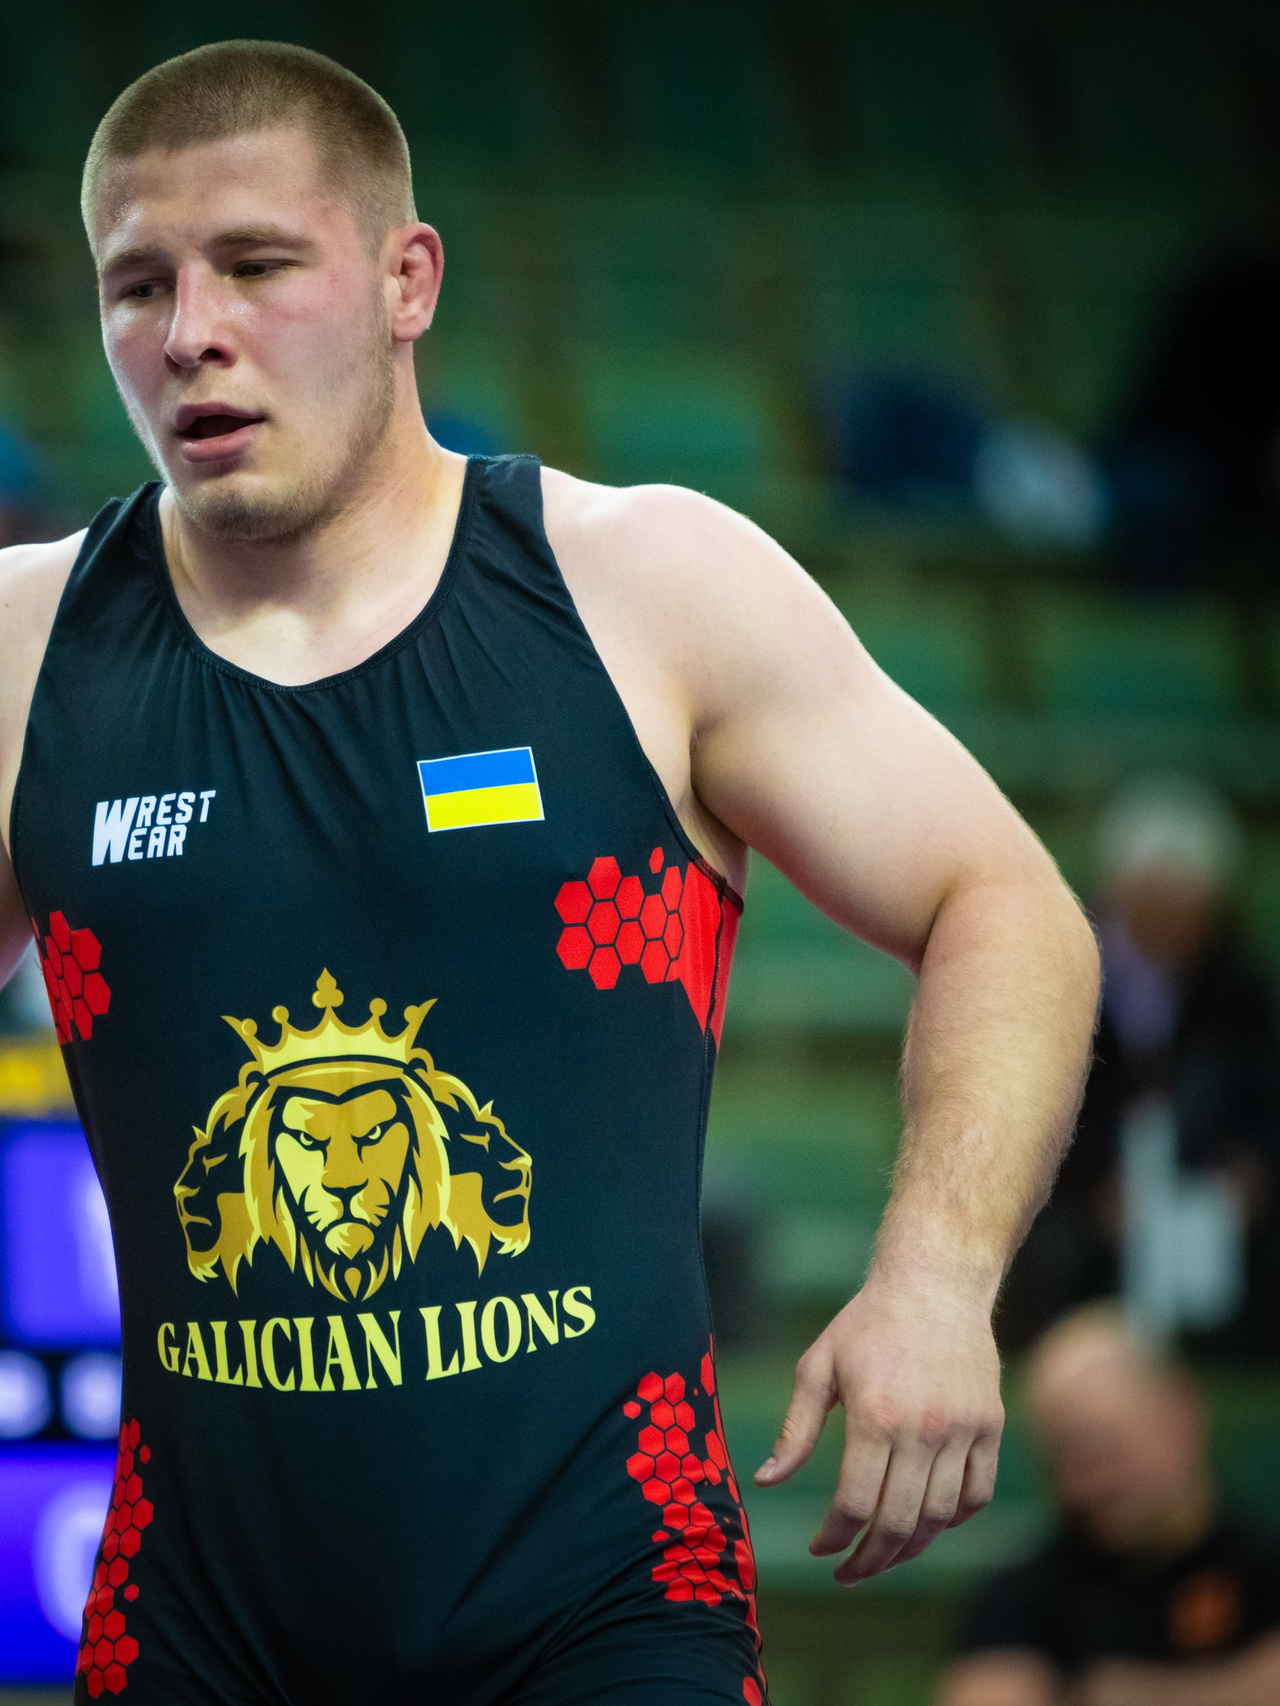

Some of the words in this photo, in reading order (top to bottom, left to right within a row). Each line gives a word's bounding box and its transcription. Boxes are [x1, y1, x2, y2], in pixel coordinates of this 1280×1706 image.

[92, 789, 217, 867] WREST
[157, 1309, 403, 1392] GALICIAN
[419, 1286, 597, 1381] LIONS
